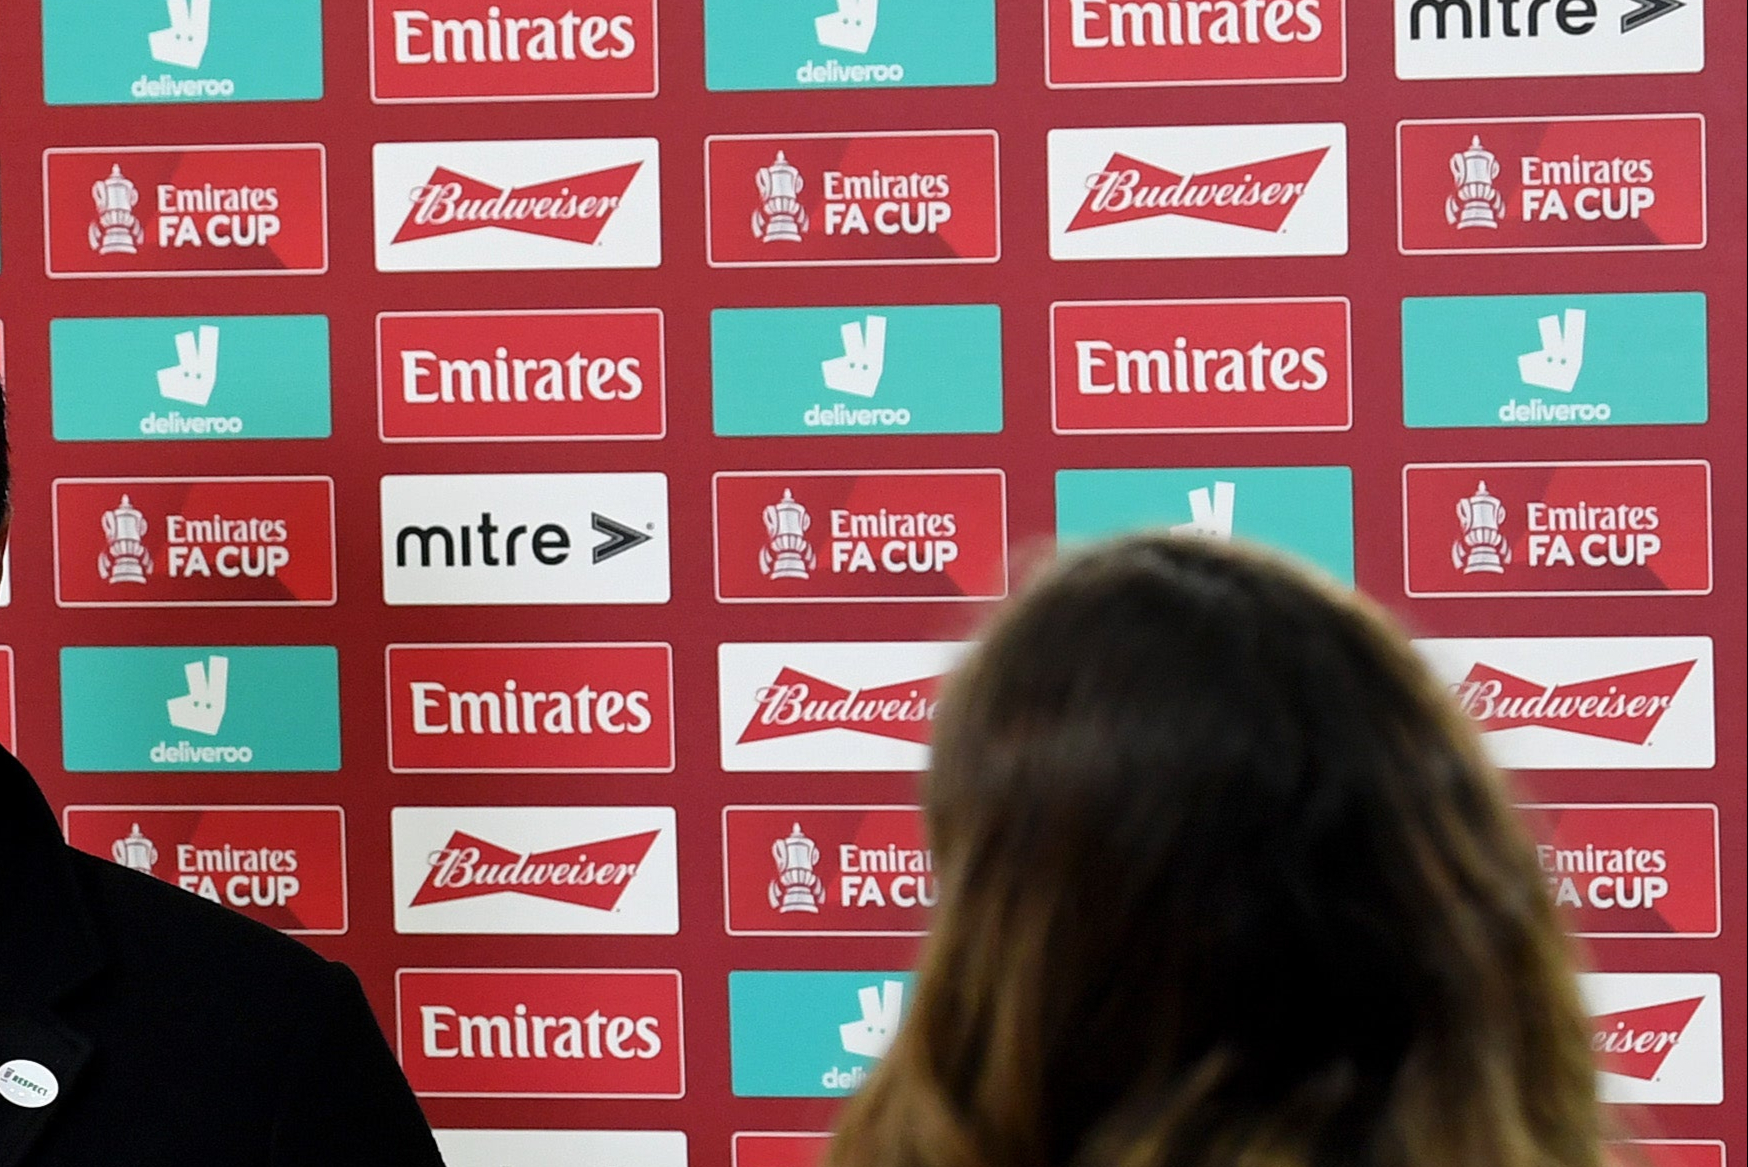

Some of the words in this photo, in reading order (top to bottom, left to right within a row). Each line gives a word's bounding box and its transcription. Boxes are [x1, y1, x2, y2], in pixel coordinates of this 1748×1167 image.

[393, 6, 635, 64] Emirates
[1070, 0, 1322, 48] Emirates
[1410, 0, 1598, 40] mitre
[131, 75, 235, 97] deliveroo
[796, 60, 904, 82] deliveroo
[823, 169, 950, 200] Emirates
[1521, 154, 1653, 186] Emirates
[157, 183, 279, 213] Emirates
[409, 181, 622, 225] Budweiser
[1085, 168, 1307, 211] Budweiser
[1522, 188, 1569, 221] FA
[1574, 186, 1655, 221] CUP
[158, 215, 202, 247] FA
[206, 214, 280, 247] CUP
[825, 203, 869, 235] FA
[874, 201, 951, 234] CUP
[401, 347, 643, 403] Emirates
[1075, 336, 1328, 394] Emirates
[140, 411, 243, 435] deliveroo
[803, 403, 911, 427] deliveroo
[1498, 398, 1611, 422] deliveroo
[166, 514, 287, 544] Emirates
[831, 508, 956, 538] Emirates
[1527, 501, 1659, 532] Emirates
[396, 512, 571, 567] mitre
[1528, 534, 1575, 567] FA
[1580, 533, 1661, 567] CUP
[168, 546, 211, 577] FA
[215, 545, 290, 577] CUP
[832, 541, 877, 573] FA
[881, 540, 958, 573] CUP
[410, 679, 652, 734] Emirates
[1450, 680, 1672, 722] Budweiser
[149, 740, 253, 763] deliveroo
[177, 844, 298, 872] Emirates
[427, 847, 639, 889] Budweiser
[226, 875, 300, 906] CUP
[841, 875, 886, 907] FA
[890, 875, 939, 908] CU
[1549, 876, 1583, 908] A
[1587, 876, 1668, 909] CUP
[420, 1003, 662, 1059] Emirates
[1591, 1021, 1679, 1053] eiser
[11, 1075, 48, 1096] RESPECT
